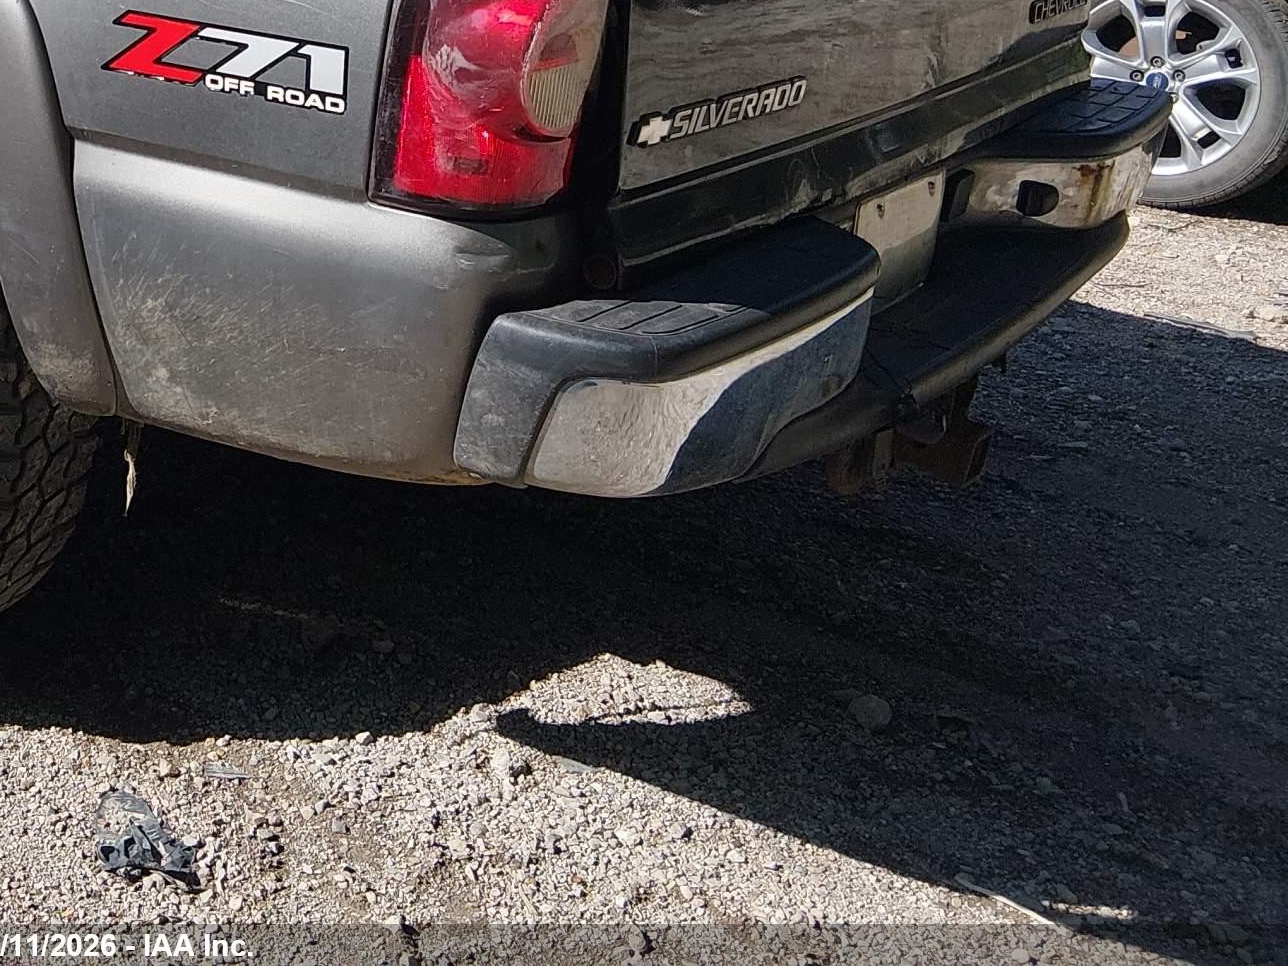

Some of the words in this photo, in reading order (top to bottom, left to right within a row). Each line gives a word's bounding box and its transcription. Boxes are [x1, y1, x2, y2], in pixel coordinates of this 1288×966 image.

[101, 10, 349, 97] Z71
[204, 74, 255, 96] OFF
[265, 85, 346, 114] ROAD
[669, 80, 807, 140] SILVERADO
